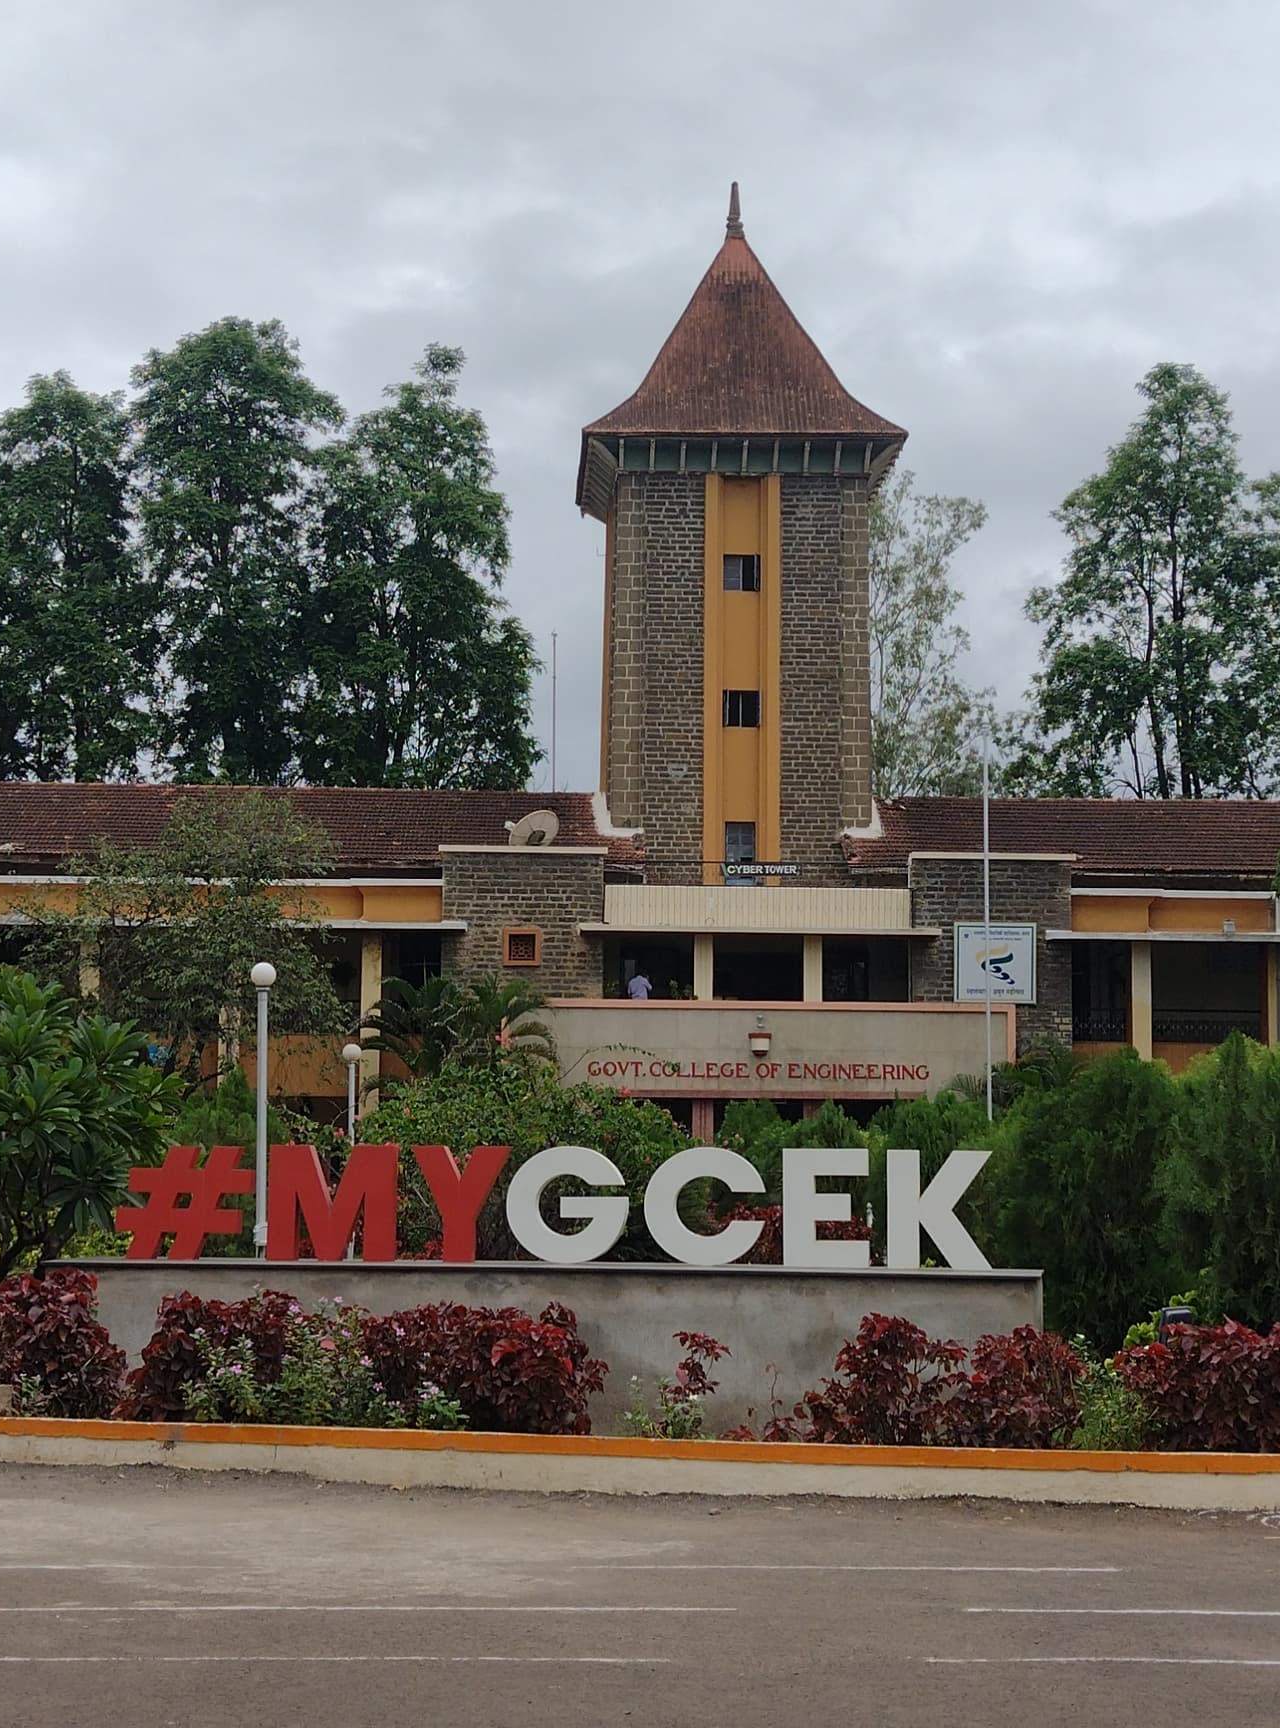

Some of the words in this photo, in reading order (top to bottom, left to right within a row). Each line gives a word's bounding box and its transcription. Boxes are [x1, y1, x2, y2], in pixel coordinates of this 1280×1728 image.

[727, 864, 763, 874] CYBER
[764, 864, 797, 874] TOWER
[588, 1061, 647, 1078] GOVT.
[649, 1061, 749, 1079] COLLEGE
[755, 1062, 783, 1079] OF
[788, 1062, 930, 1080] ENGINEERING
